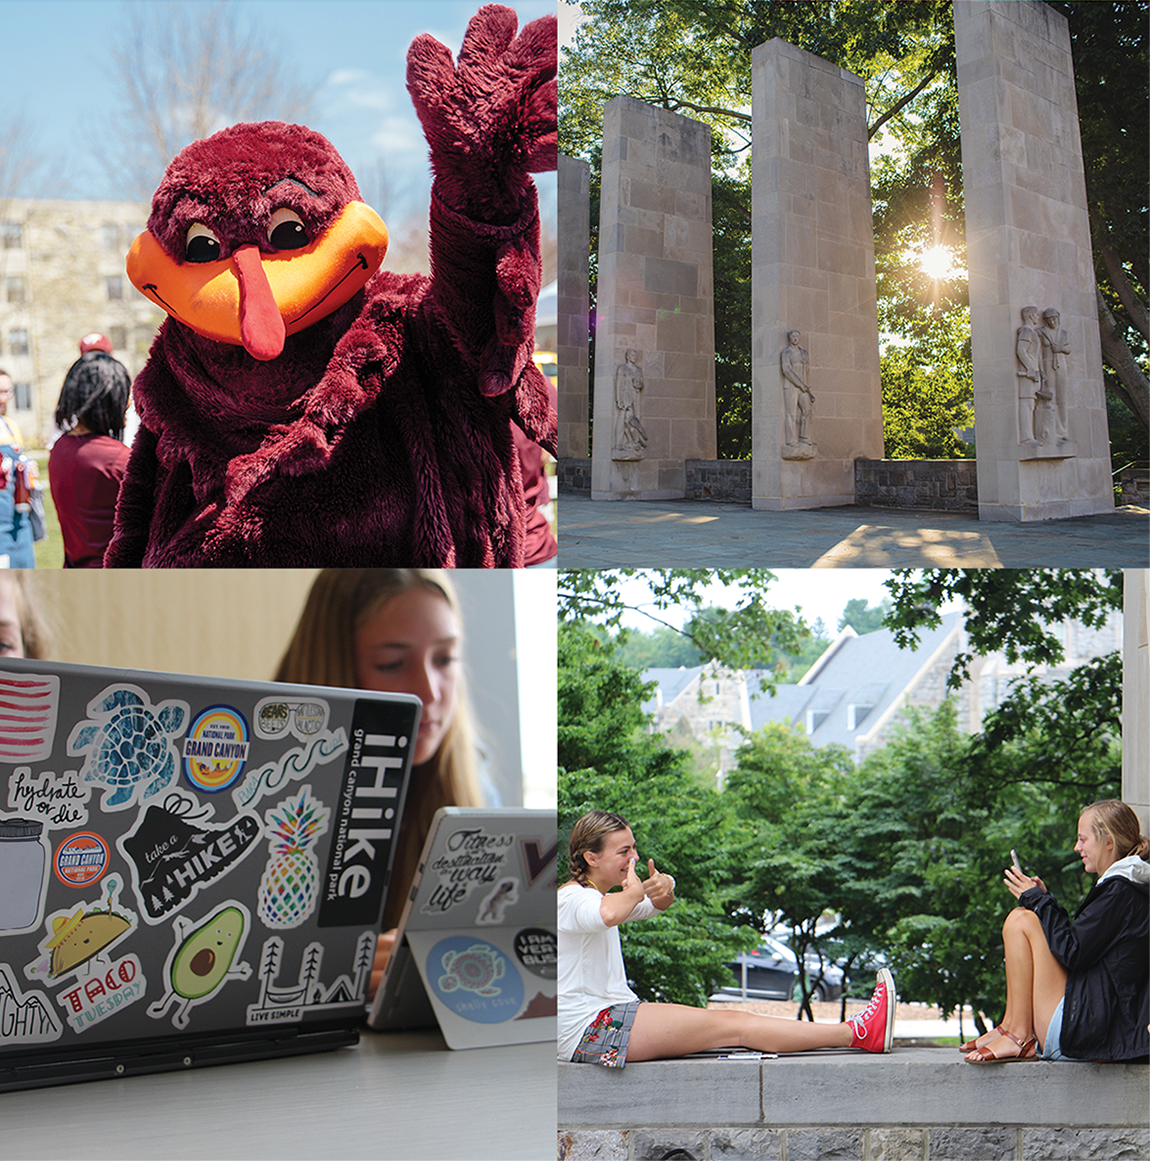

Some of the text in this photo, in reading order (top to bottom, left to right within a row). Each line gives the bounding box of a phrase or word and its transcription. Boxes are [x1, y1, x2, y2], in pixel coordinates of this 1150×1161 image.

[260, 704, 288, 719] BEARS
[202, 730, 236, 740] NATIONAL PARK
[186, 740, 247, 759] GRAND CANYON
[14, 772, 86, 812] hydrate
[237, 776, 259, 804] PURA
[36, 801, 56, 815] or
[50, 803, 83, 825] die
[327, 728, 364, 901] grand canyon national park
[338, 734, 408, 899] iHike
[145, 835, 178, 863] take a
[448, 829, 514, 852] Fitness
[172, 831, 238, 888] HIKE
[519, 839, 558, 887] V
[450, 865, 498, 885] way
[429, 883, 467, 911] life
[517, 943, 558, 954] VER
[519, 934, 554, 945] I AM
[62, 960, 137, 1013] TACO
[72, 981, 141, 1028] TUESDAY
[251, 1008, 300, 1021] LIVE SIMPLE
